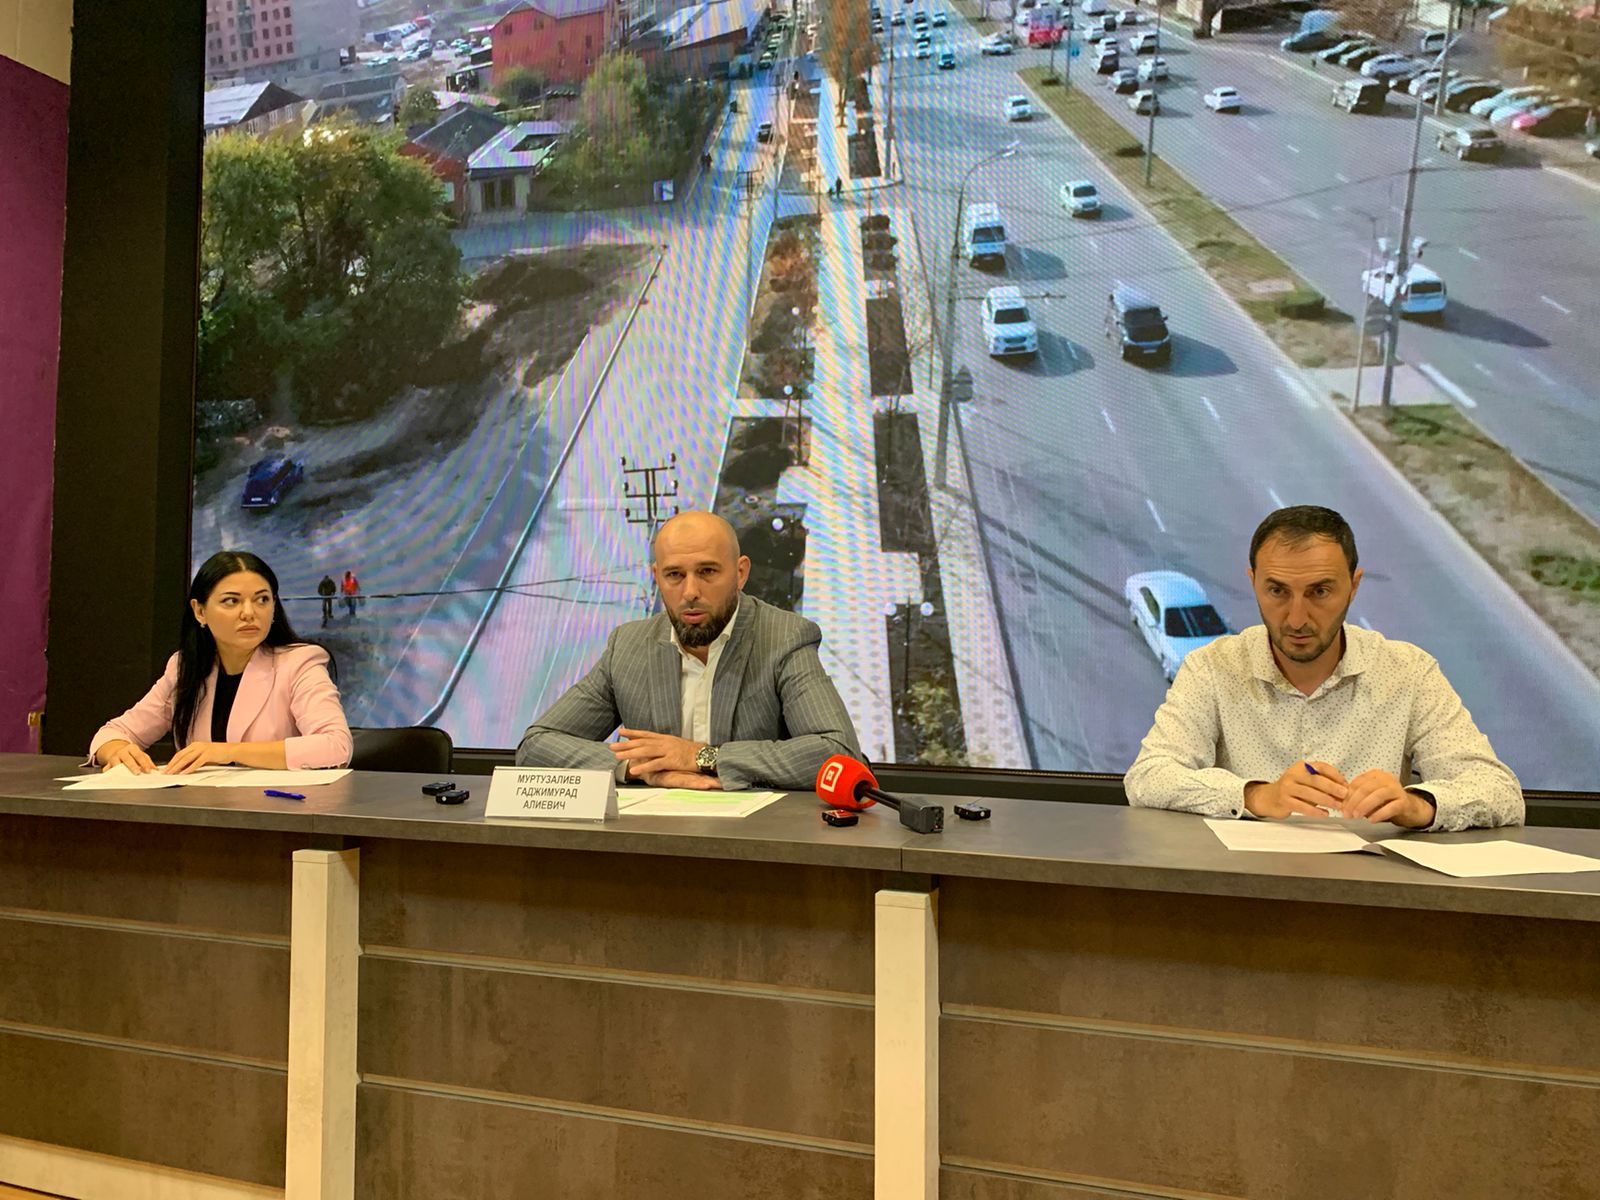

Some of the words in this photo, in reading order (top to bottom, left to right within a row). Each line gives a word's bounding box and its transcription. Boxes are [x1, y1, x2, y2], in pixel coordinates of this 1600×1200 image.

[517, 774, 581, 785] МУРТУЗАЛИЕВ
[516, 787, 578, 798] ГАДЖИМУРАД
[523, 800, 566, 810] АЛИЕВИЧ
